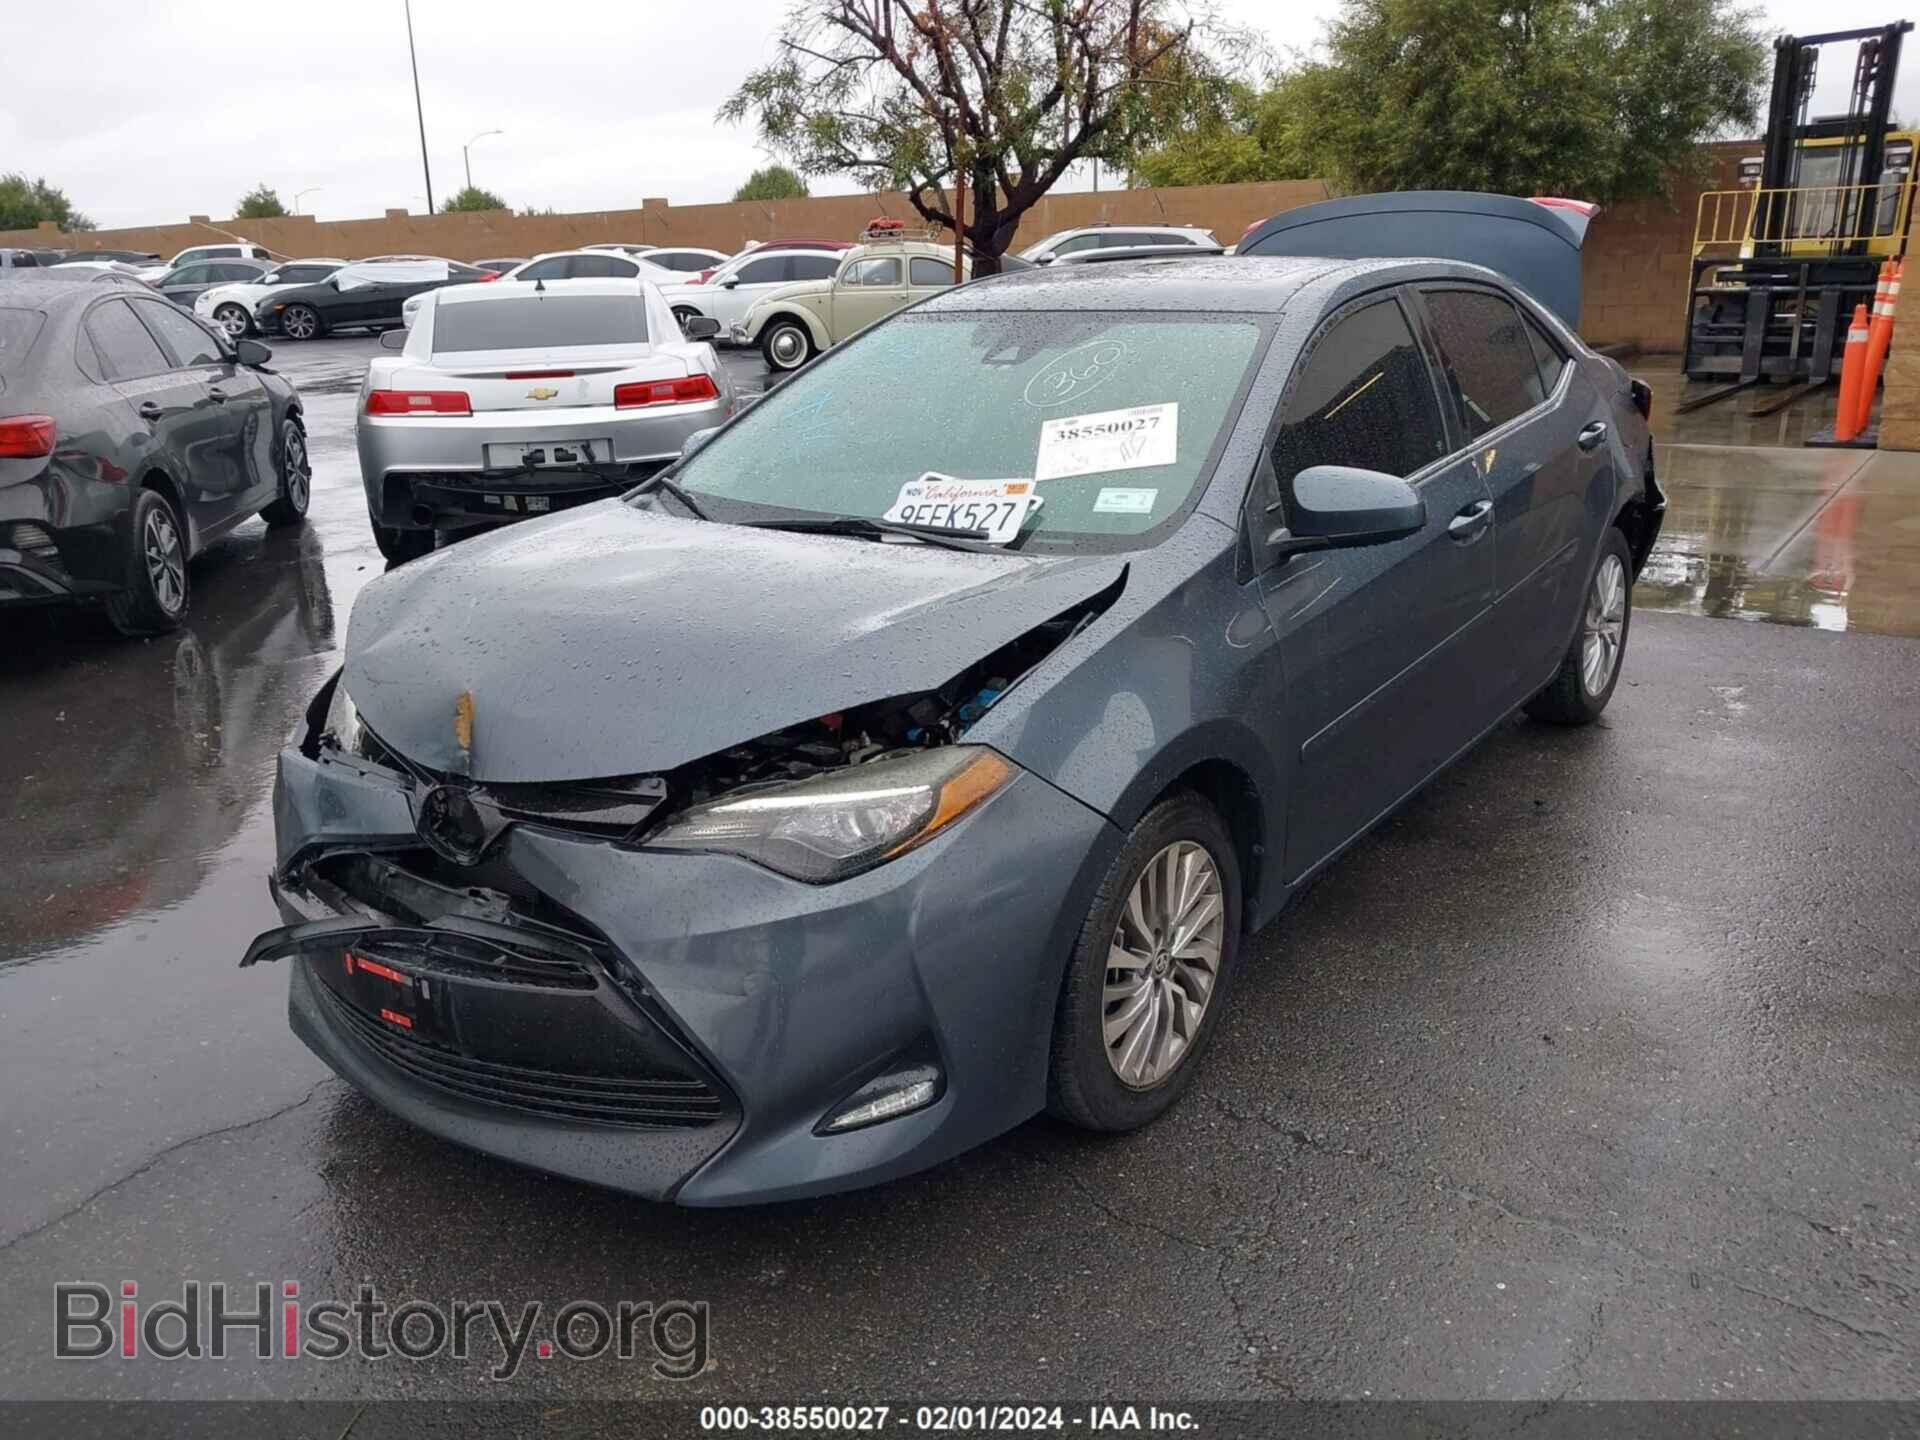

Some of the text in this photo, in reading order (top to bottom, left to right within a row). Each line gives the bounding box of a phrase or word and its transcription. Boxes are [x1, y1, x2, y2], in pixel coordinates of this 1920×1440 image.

[1043, 347, 1121, 397] 360
[1055, 416, 1161, 442] 38550027
[926, 484, 1000, 503] California
